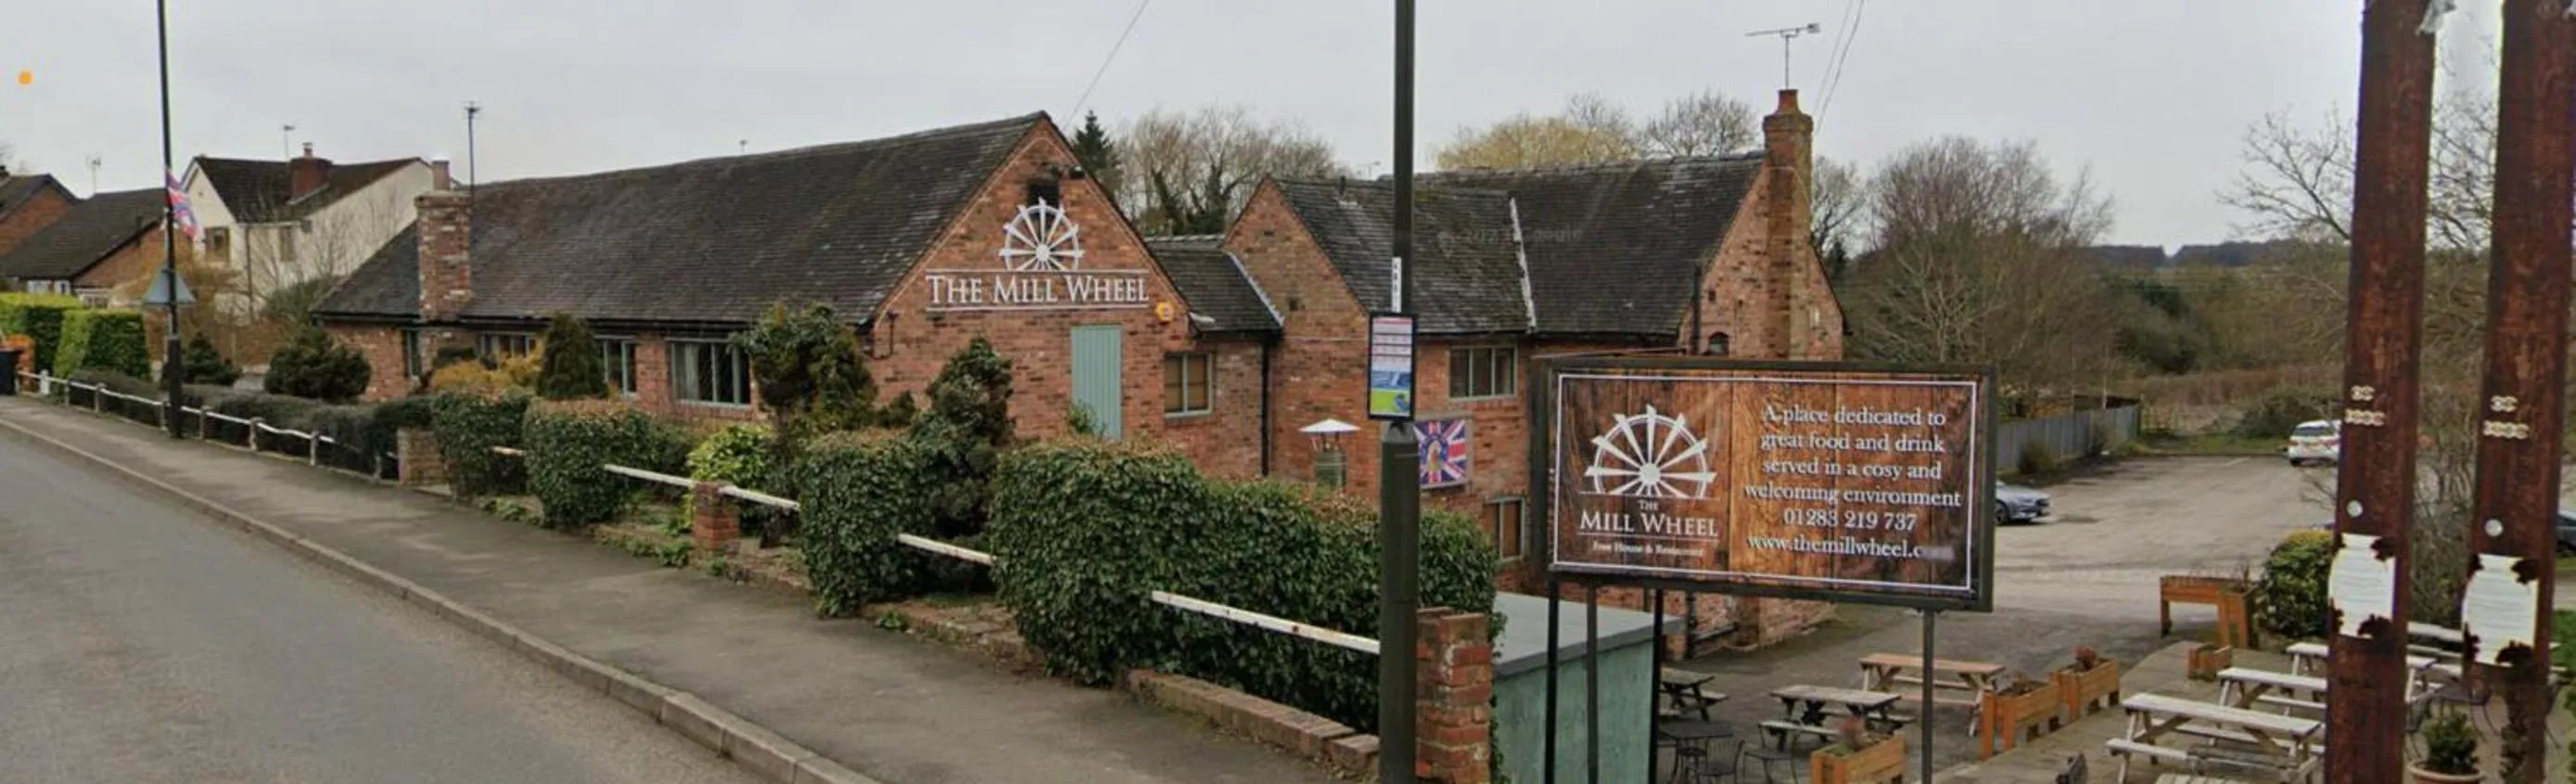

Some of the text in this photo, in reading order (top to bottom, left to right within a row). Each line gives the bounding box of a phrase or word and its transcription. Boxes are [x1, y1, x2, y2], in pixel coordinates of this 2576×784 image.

[1764, 404, 1947, 426] A place dedicated to
[1761, 431, 1945, 453] great food and drink
[1763, 456, 1942, 482] served in a cosy and
[1638, 499, 1660, 510] THE
[1744, 482, 1962, 507] welcoming environment
[1579, 510, 1719, 537] MILL WHEEL
[1783, 509, 1917, 532] 01283 219 737
